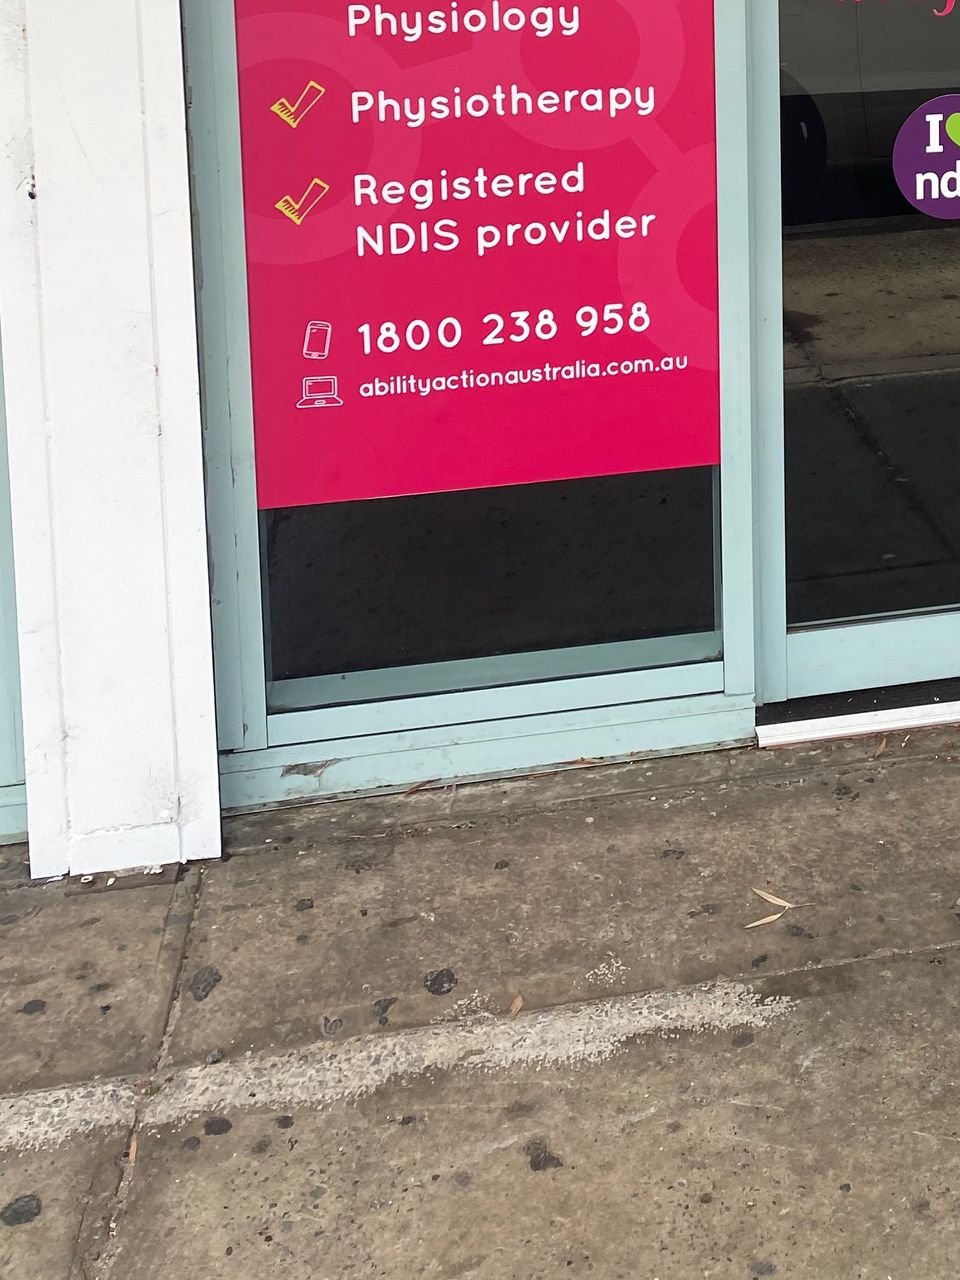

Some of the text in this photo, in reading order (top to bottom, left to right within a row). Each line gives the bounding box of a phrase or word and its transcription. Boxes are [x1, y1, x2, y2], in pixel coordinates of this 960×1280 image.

[349, 0, 580, 42] Physiology
[351, 84, 655, 128] Physiotherapy
[925, 114, 943, 153] I
[354, 162, 584, 209] Registered
[357, 210, 656, 257] NDIS provider
[357, 302, 651, 355] 1800 238 958
[359, 354, 688, 397] abilityactionaustralia.com.au
